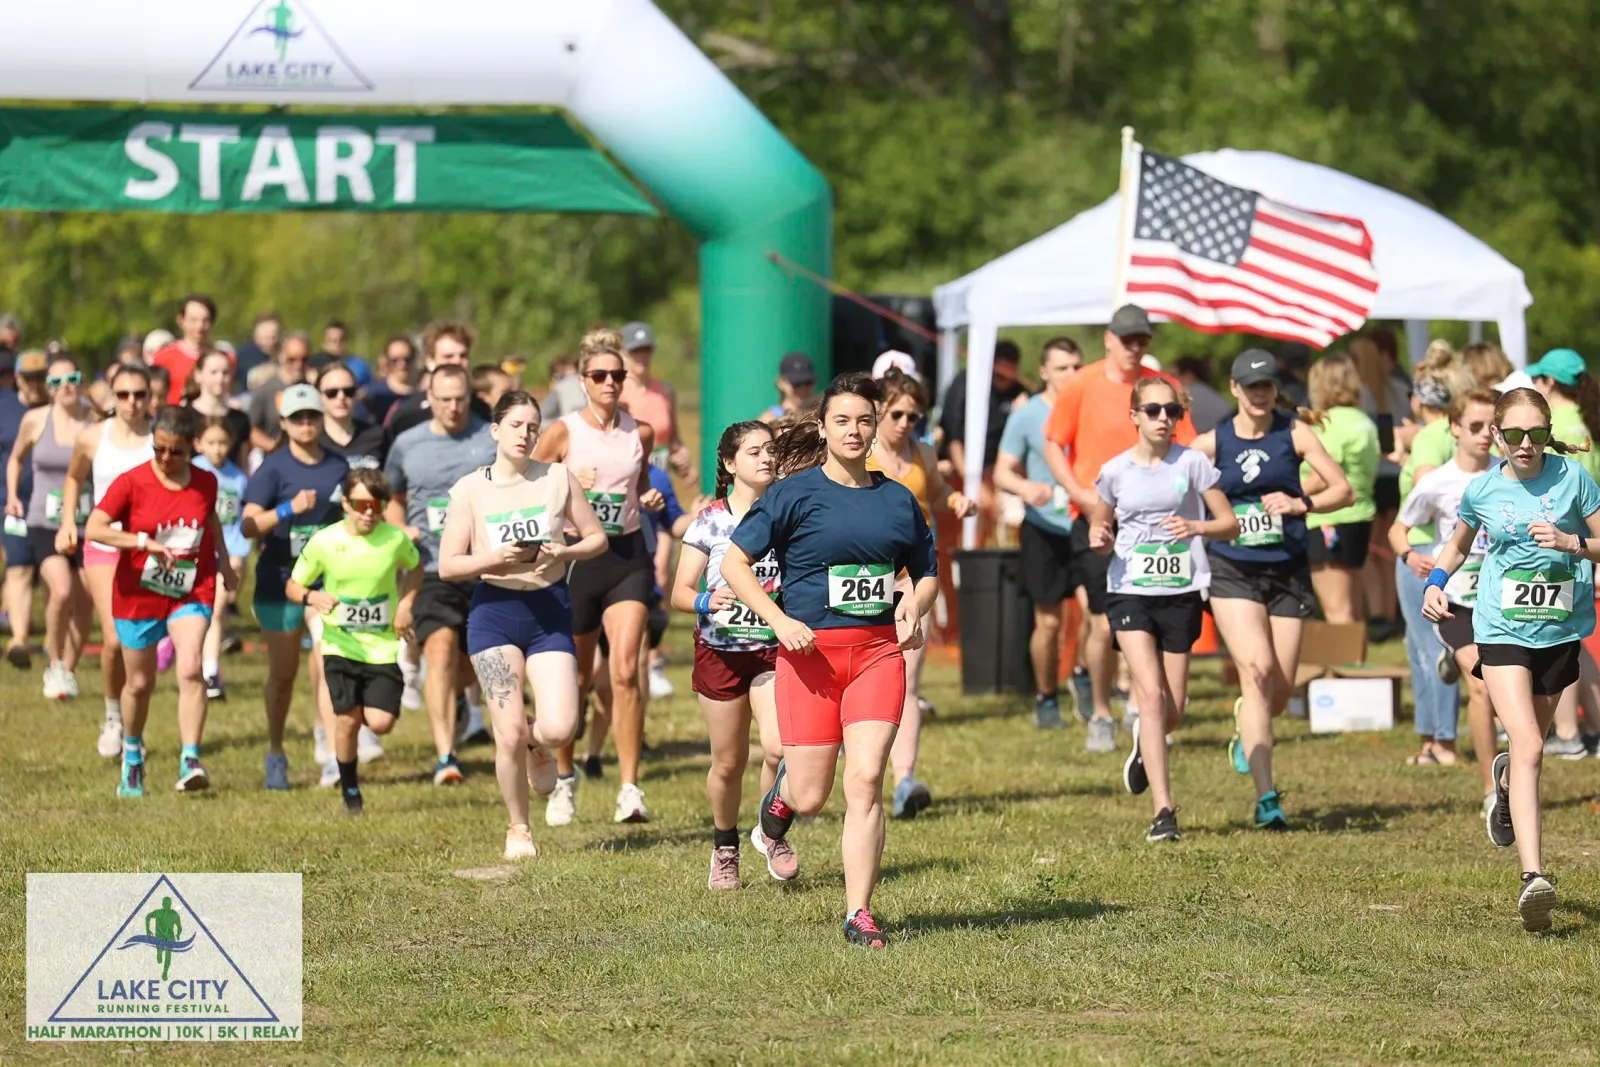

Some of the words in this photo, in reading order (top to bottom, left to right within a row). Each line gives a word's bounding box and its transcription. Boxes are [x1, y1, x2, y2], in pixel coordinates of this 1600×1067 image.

[226, 63, 276, 79] LAKE
[284, 63, 334, 79] CITY
[123, 121, 436, 204] START
[499, 518, 540, 544] 260
[151, 566, 186, 587] 268
[1143, 556, 1181, 575] 208
[841, 578, 886, 602] 264
[1514, 583, 1562, 607] 207
[346, 607, 382, 622] 294
